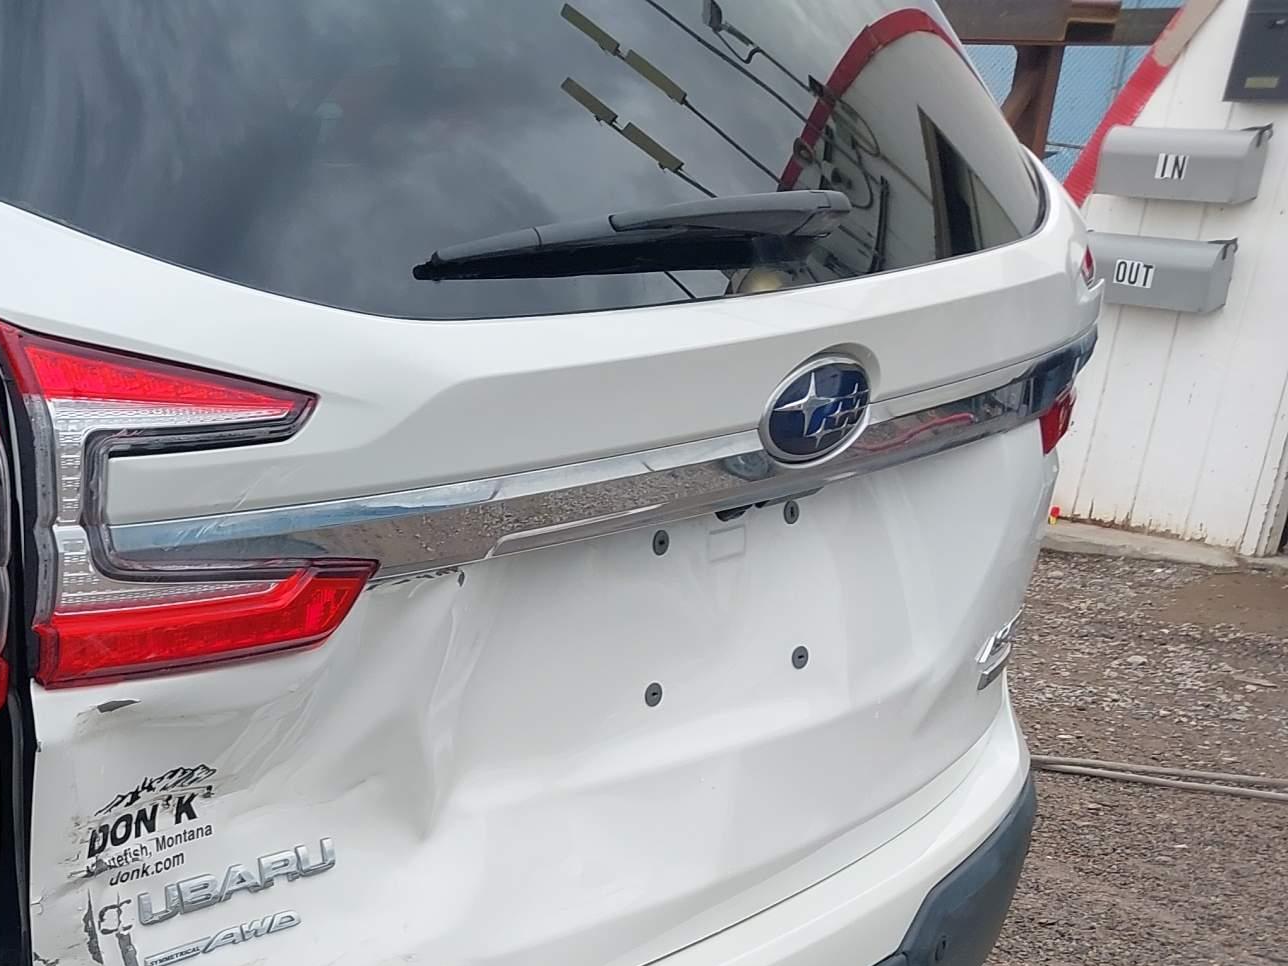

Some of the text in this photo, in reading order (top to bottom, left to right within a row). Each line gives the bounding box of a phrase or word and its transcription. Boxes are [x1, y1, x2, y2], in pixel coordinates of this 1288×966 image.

[1160, 154, 1187, 180] IN
[1115, 260, 1153, 287] OUT
[155, 824, 213, 852] Montana
[202, 909, 302, 954] AWD
